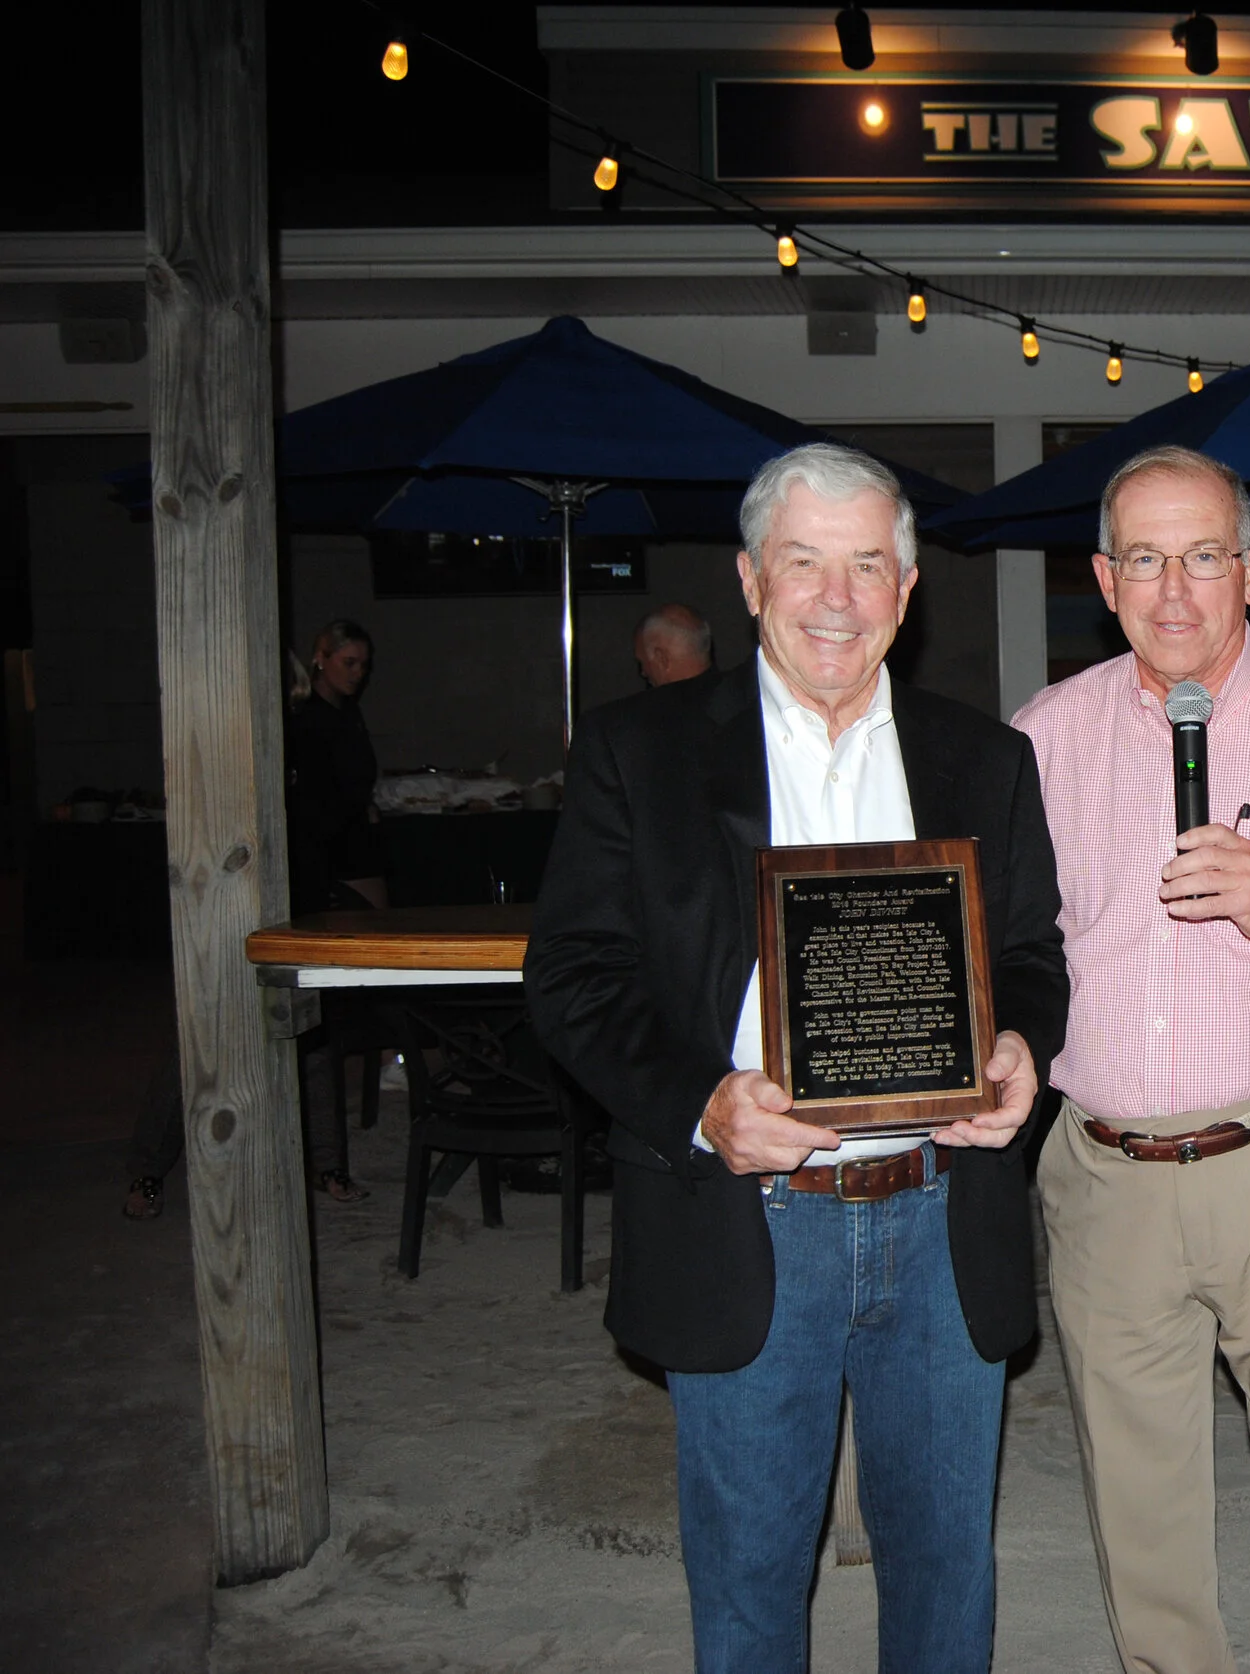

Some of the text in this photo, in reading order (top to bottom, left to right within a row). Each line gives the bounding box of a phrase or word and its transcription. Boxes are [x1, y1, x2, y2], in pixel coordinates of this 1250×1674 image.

[923, 112, 1057, 151] THE
[794, 887, 950, 902] Sea Isle City Chamber And Revitalization
[853, 924, 870, 932] year's
[809, 934, 843, 942] exemplifies
[807, 965, 843, 974] spearheaded
[848, 971, 878, 979] Excursion
[800, 998, 842, 1007] representative
[901, 1007, 916, 1015] point
[834, 1019, 851, 1027] City's
[806, 1029, 822, 1037] great
[825, 1027, 853, 1035] recession
[841, 1035, 862, 1043] today's
[865, 1034, 884, 1042] public
[830, 1050, 851, 1058] helped
[897, 1045, 932, 1054] government
[809, 1059, 834, 1067] together
[851, 1056, 883, 1064] revitalized
[915, 1053, 928, 1061] City
